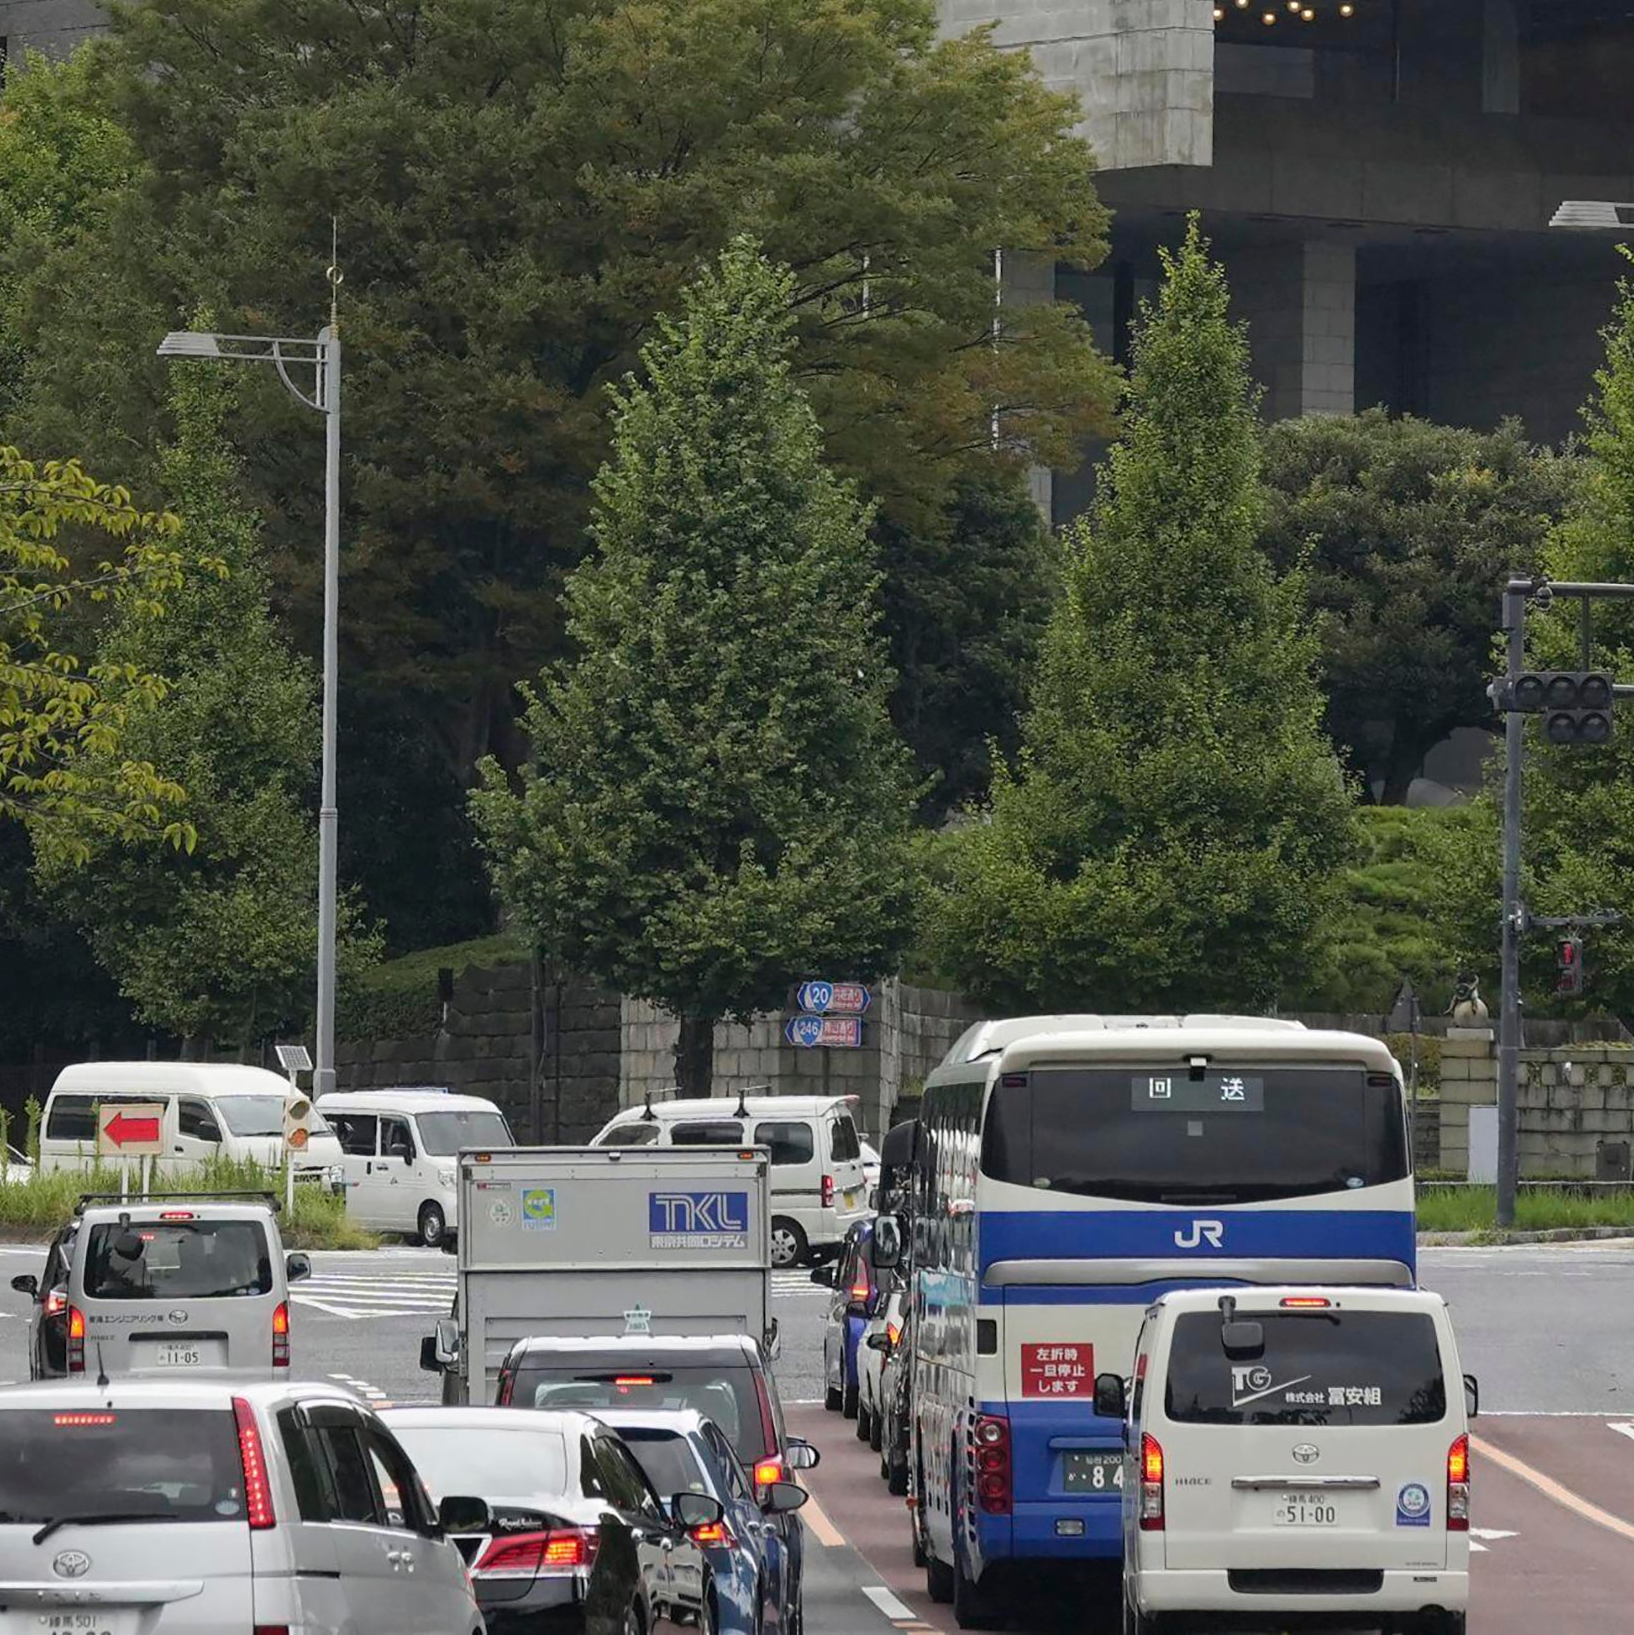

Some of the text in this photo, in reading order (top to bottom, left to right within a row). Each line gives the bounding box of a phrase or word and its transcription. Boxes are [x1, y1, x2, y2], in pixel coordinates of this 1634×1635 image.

[812, 987, 829, 1004] 20
[800, 1021, 819, 1036] 246
[655, 1194, 742, 1231] TKL
[1174, 1220, 1223, 1248] JR
[167, 1351, 199, 1364] 11-05
[1036, 1348, 1078, 1361] 左折時
[1029, 1364, 1085, 1377] 一旦停止
[1038, 1380, 1079, 1393] します
[1285, 1392, 1325, 1404] 株式会社
[1287, 1506, 1336, 1523] 51-00
